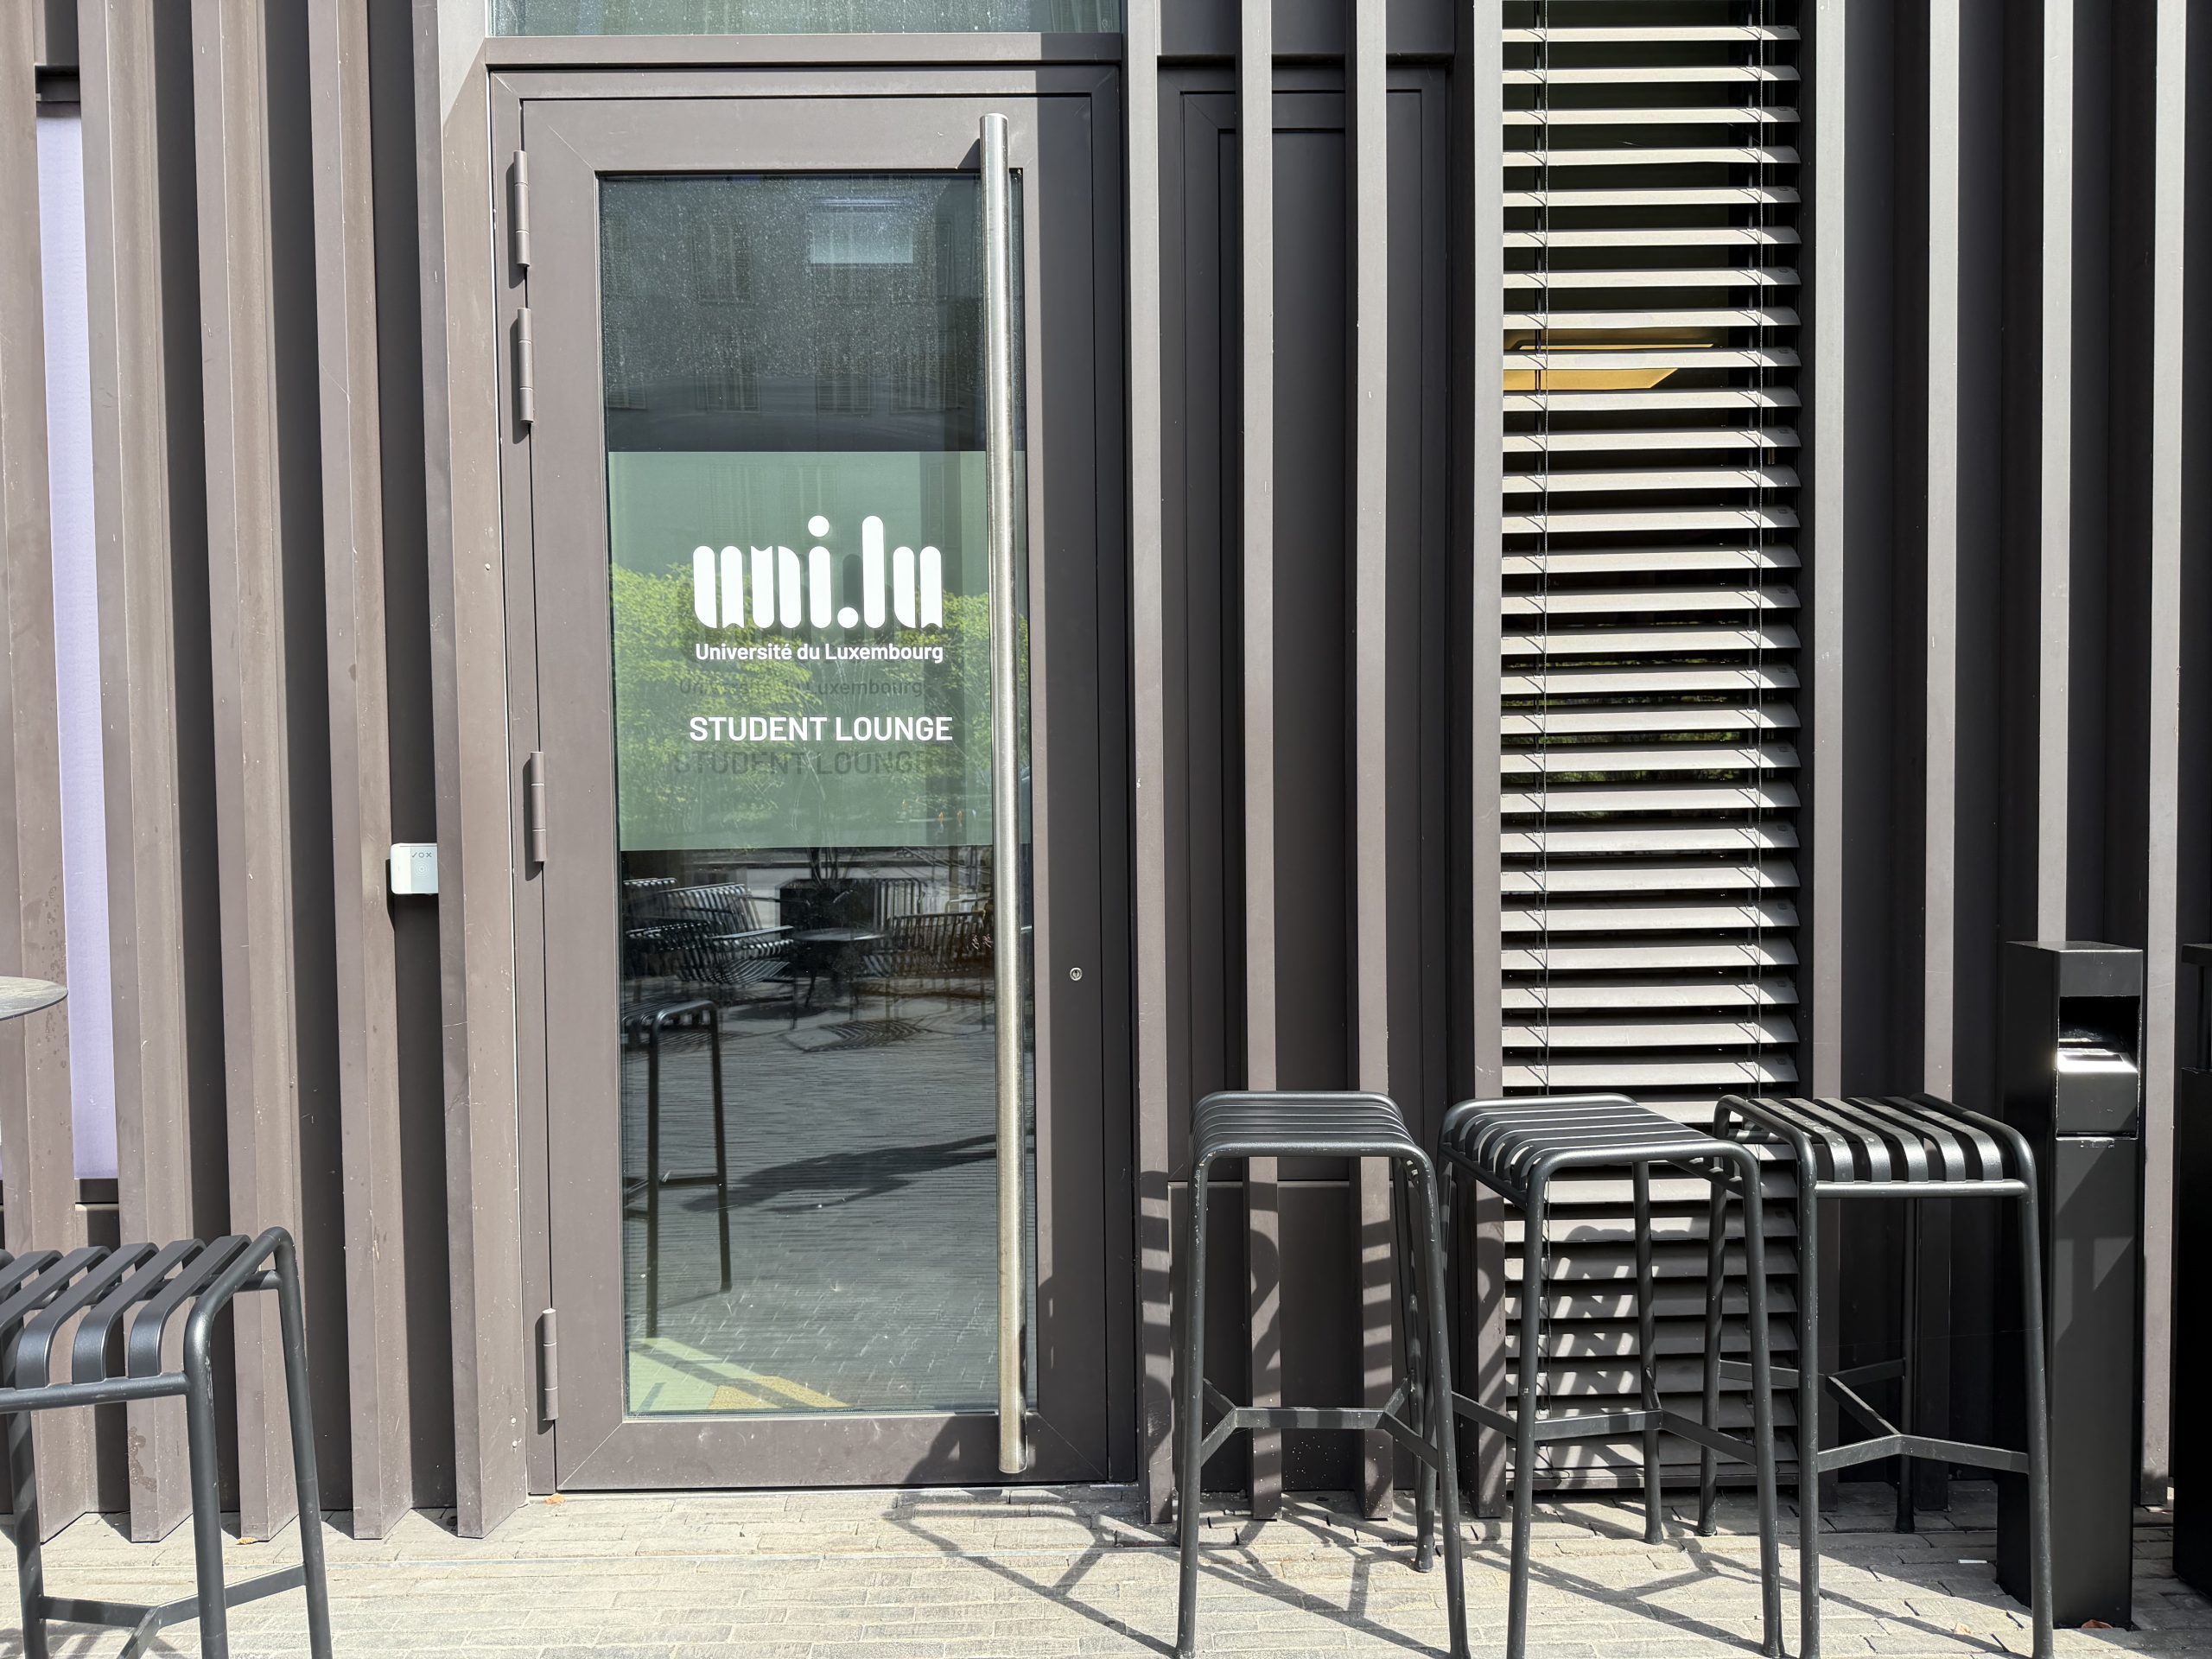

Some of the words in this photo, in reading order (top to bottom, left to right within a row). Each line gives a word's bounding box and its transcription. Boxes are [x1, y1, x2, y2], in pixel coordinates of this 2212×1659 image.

[692, 515, 943, 629] uni.lu
[696, 642, 792, 660] Université
[797, 643, 820, 660] du
[825, 643, 944, 664] Luxembourg
[690, 716, 828, 741] STUDENT
[836, 716, 953, 741] LOUNGE
